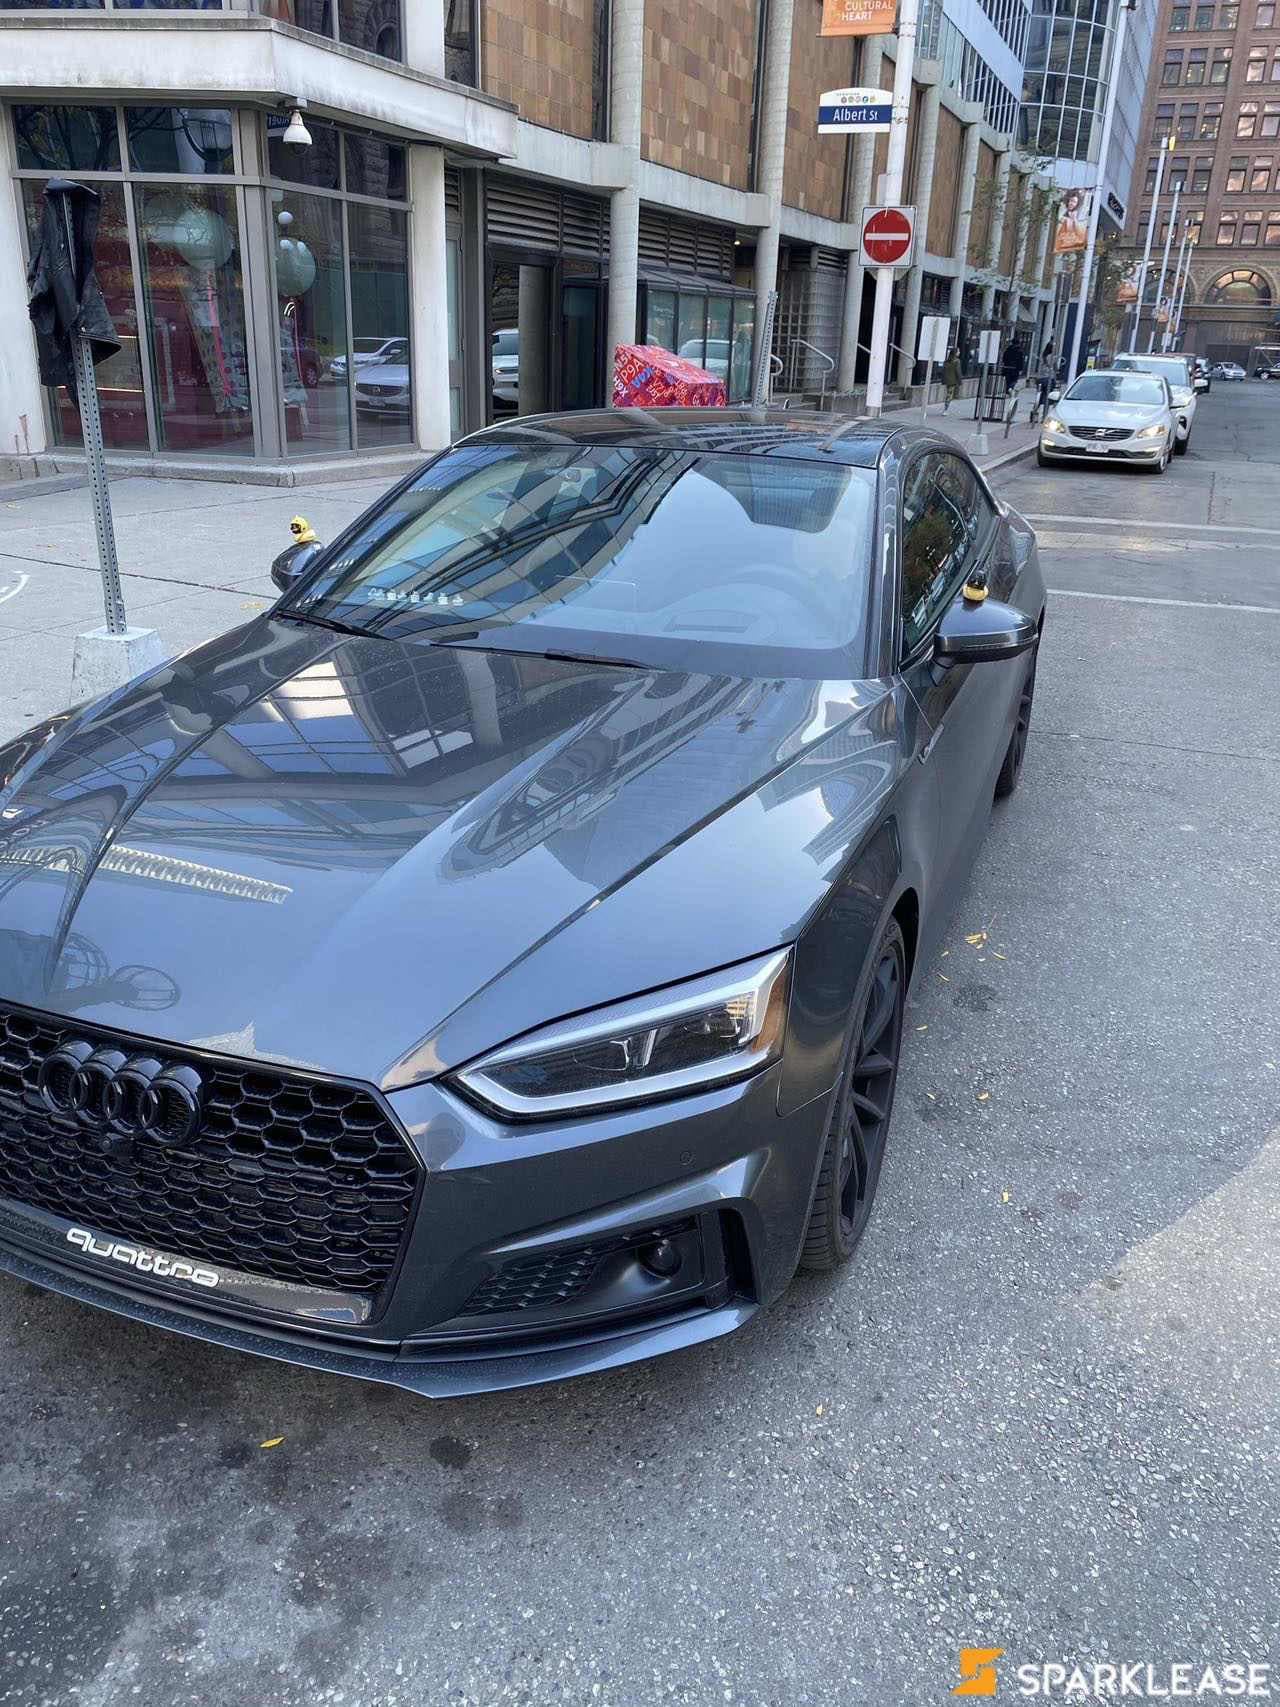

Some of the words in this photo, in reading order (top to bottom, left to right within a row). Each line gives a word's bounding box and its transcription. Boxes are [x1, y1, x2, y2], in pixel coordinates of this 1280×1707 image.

[844, 0, 894, 11] CULTURAL
[841, 10, 873, 21] HEART
[833, 108, 867, 121] Albert
[66, 1227, 220, 1288] quattro
